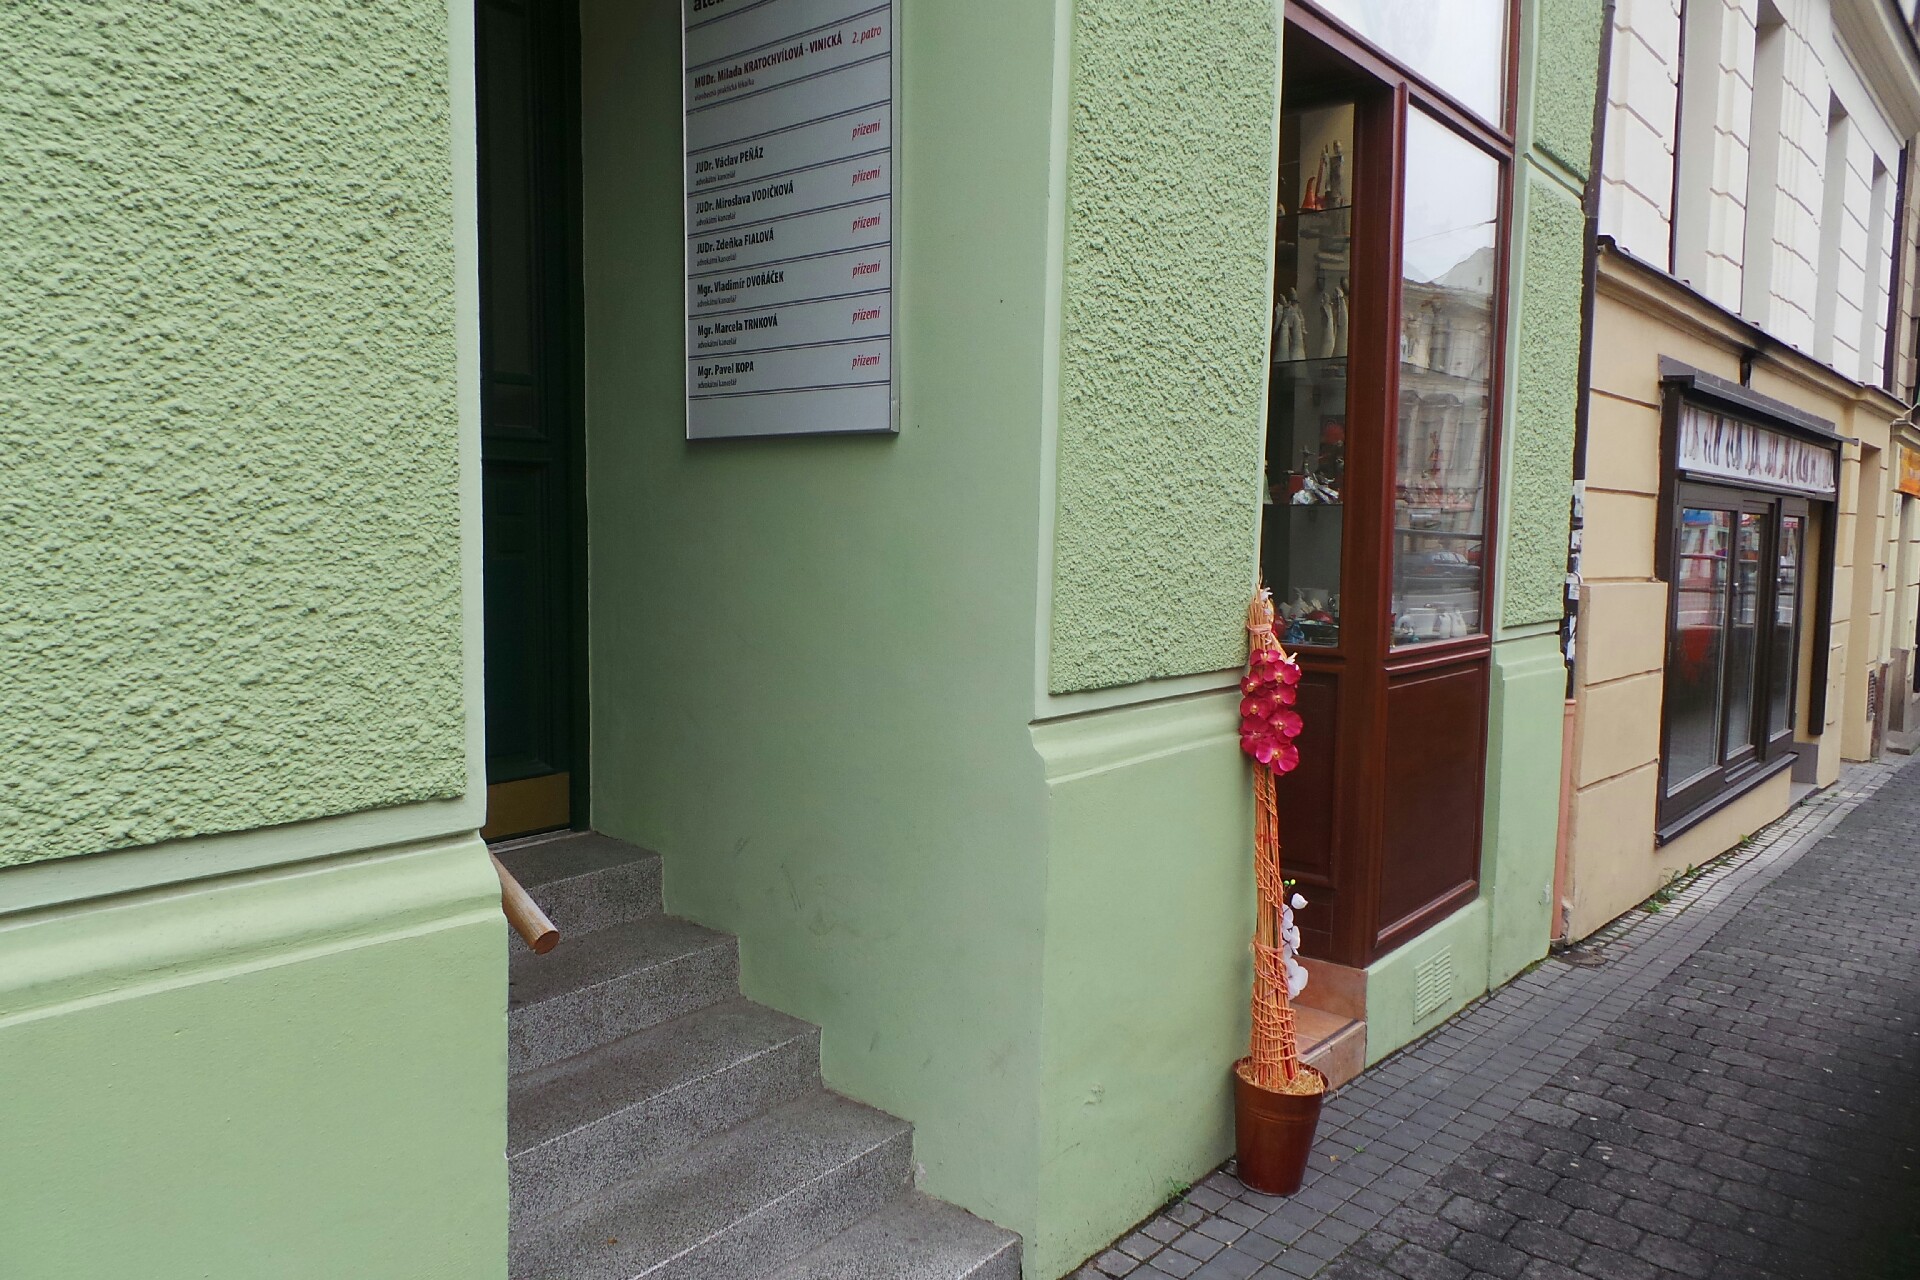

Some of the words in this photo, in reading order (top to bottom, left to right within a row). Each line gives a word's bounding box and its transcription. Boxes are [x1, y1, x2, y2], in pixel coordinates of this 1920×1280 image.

[852, 31, 859, 44] 2.
[860, 25, 882, 44] patro
[694, 75, 716, 89] MUDr.
[717, 65, 742, 82] Milada
[743, 42, 804, 74] KRATOCHVÍLOVÁ
[809, 30, 843, 54] VINICKÁ
[852, 118, 881, 141] přízemí
[695, 160, 714, 174] JUDr.
[715, 154, 738, 169] Václav
[739, 146, 764, 164] PEŇÁZ
[852, 165, 881, 187] přízemí
[695, 200, 714, 214] JUDr.
[715, 194, 751, 210] Miroslava
[751, 180, 794, 202] VODIČKOVÁ
[852, 212, 881, 233] přízemí
[696, 242, 715, 254] JUDr.
[716, 236, 743, 251] Zdeňka
[744, 227, 774, 245] FIALOVÁ
[852, 259, 881, 279] přízemí
[696, 284, 713, 297] Mgr.
[713, 277, 745, 293] Vladimír
[746, 270, 784, 288] DVOŘÁČEK
[697, 325, 714, 338] Mgr.
[714, 320, 743, 334] Marcela
[743, 313, 778, 330] TRNKOVÁ
[852, 306, 881, 325] přízemí
[697, 365, 714, 379] Mgr.
[714, 362, 734, 375] Pavel
[735, 360, 754, 373] KOPA
[851, 352, 881, 370] přízemí
